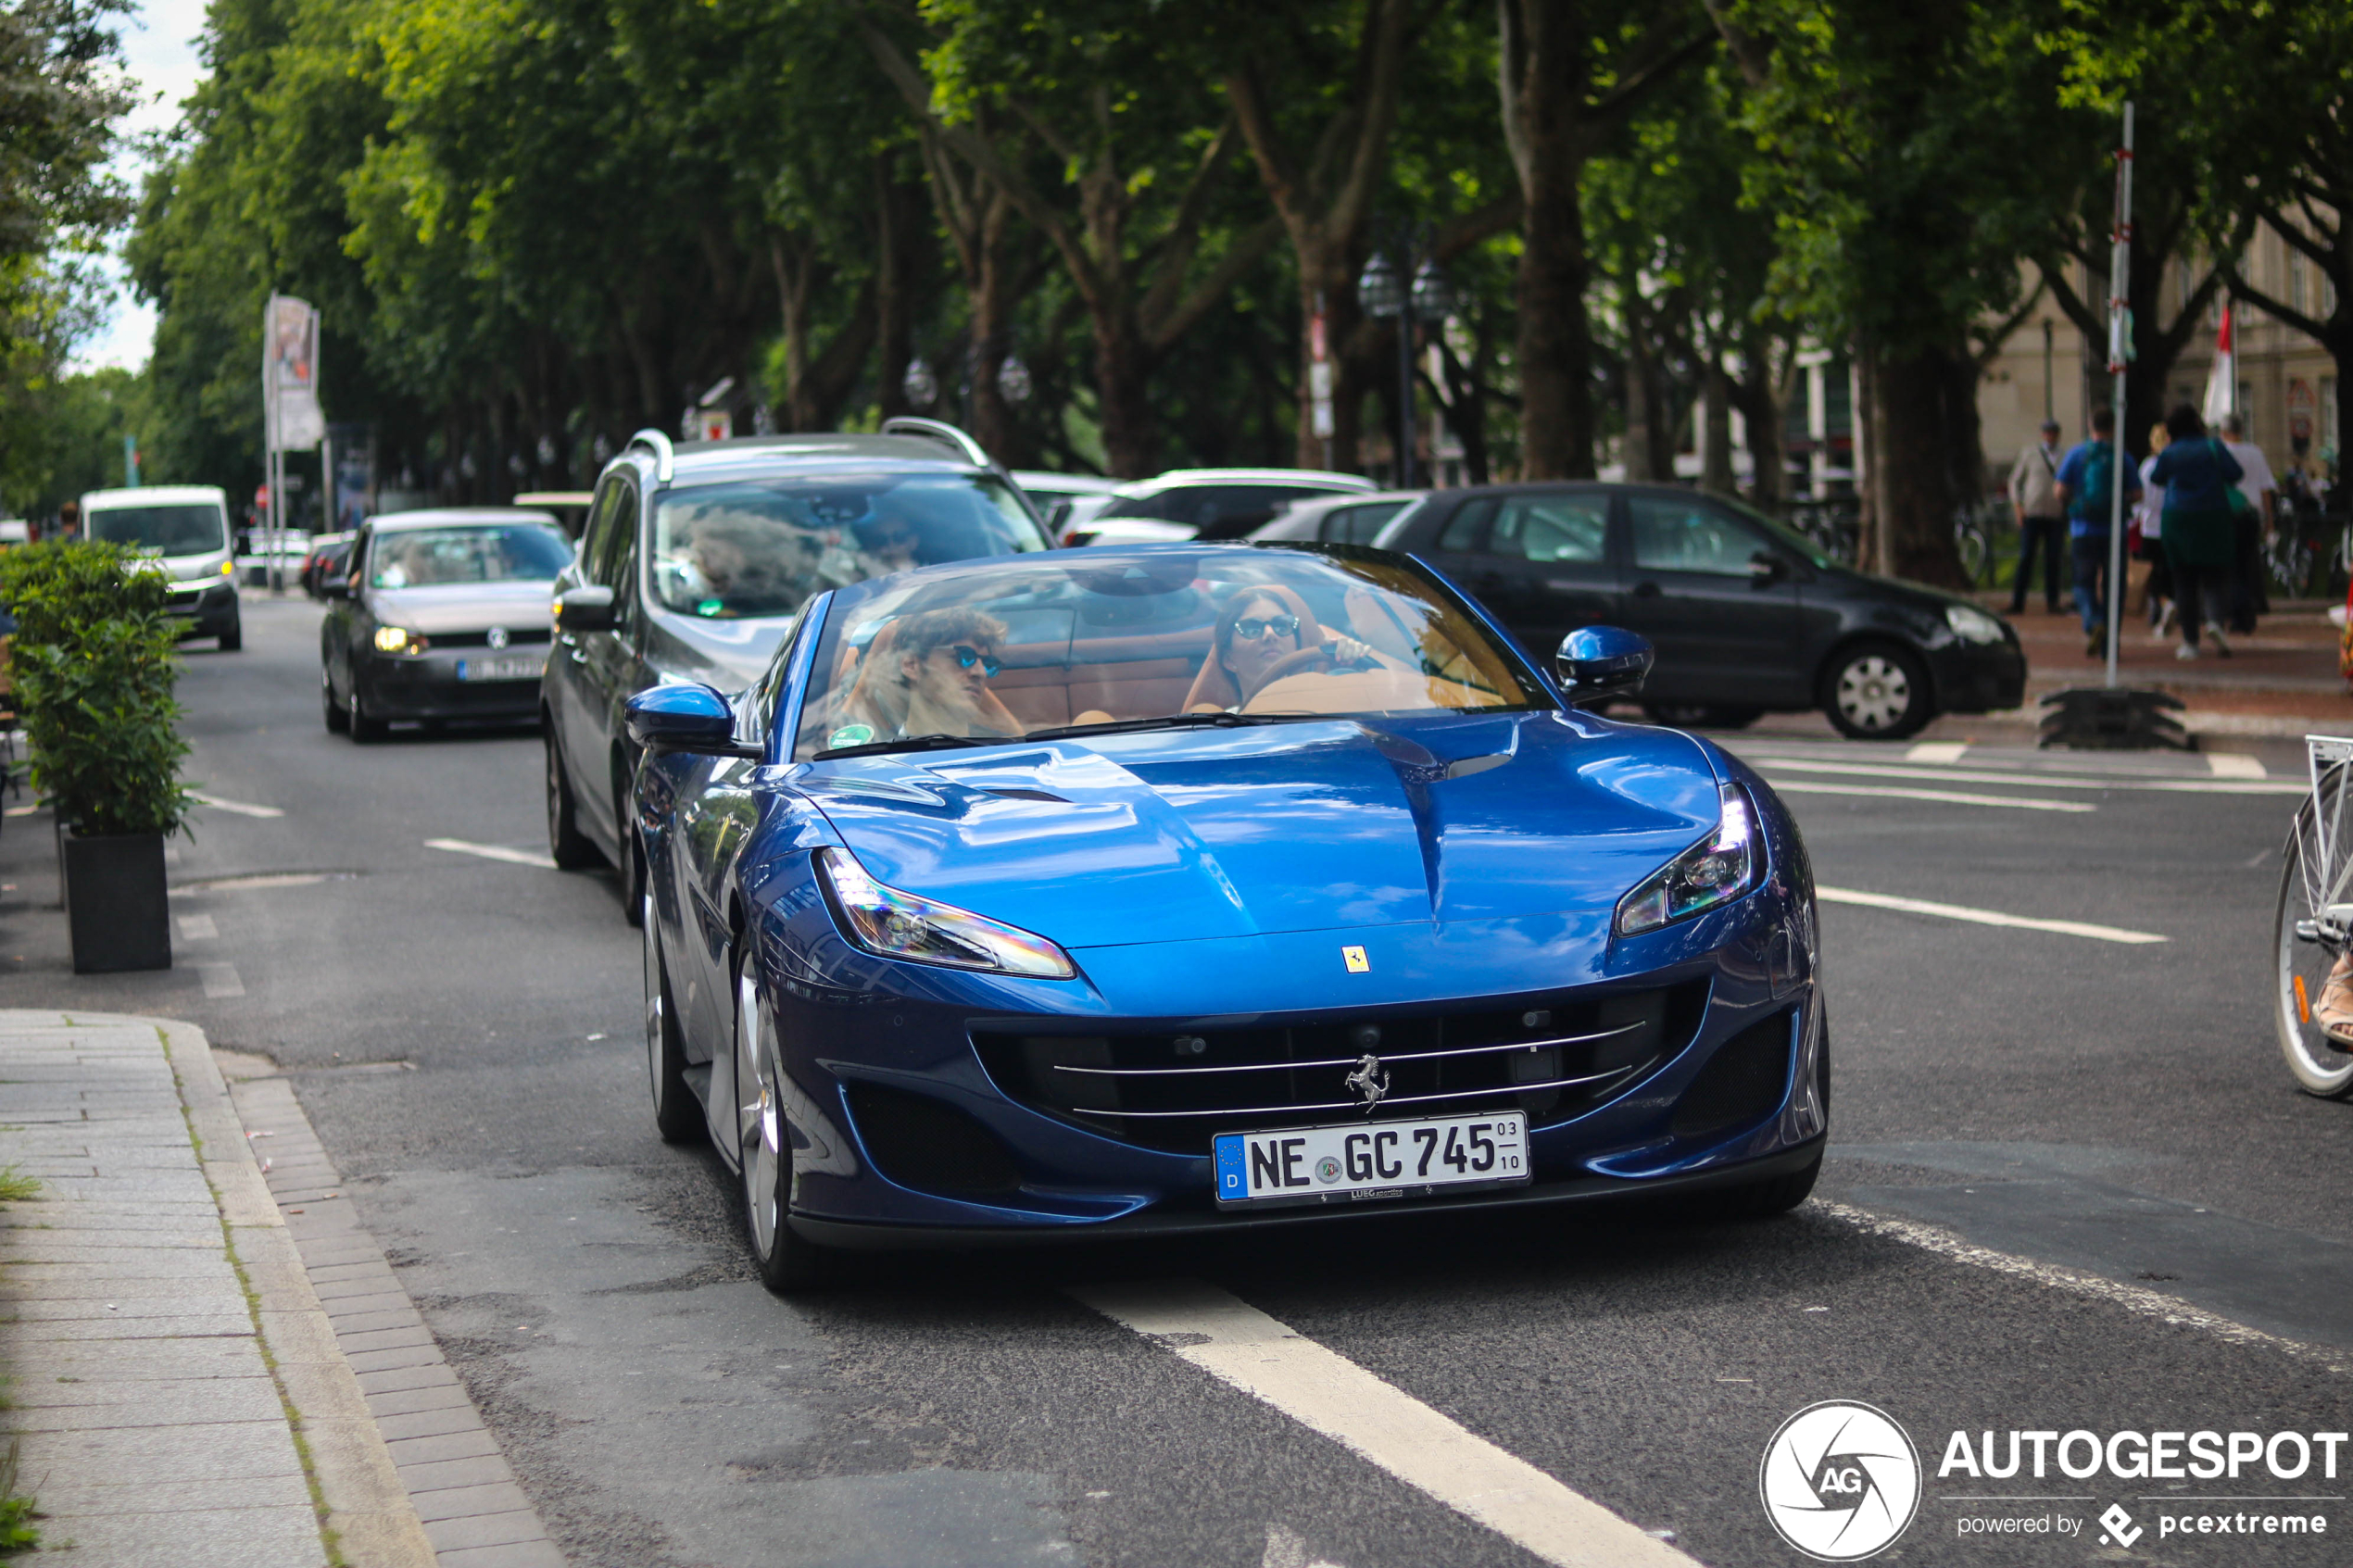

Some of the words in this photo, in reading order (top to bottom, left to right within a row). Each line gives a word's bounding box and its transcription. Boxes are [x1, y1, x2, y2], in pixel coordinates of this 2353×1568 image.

[1498, 1122, 1516, 1135] 03
[1252, 1138, 1310, 1189] NE
[1345, 1132, 1402, 1181] GC
[1413, 1123, 1494, 1176] 745
[1501, 1155, 1519, 1170] 10
[1227, 1174, 1238, 1187] D
[1352, 1189, 1375, 1198] LUEG
